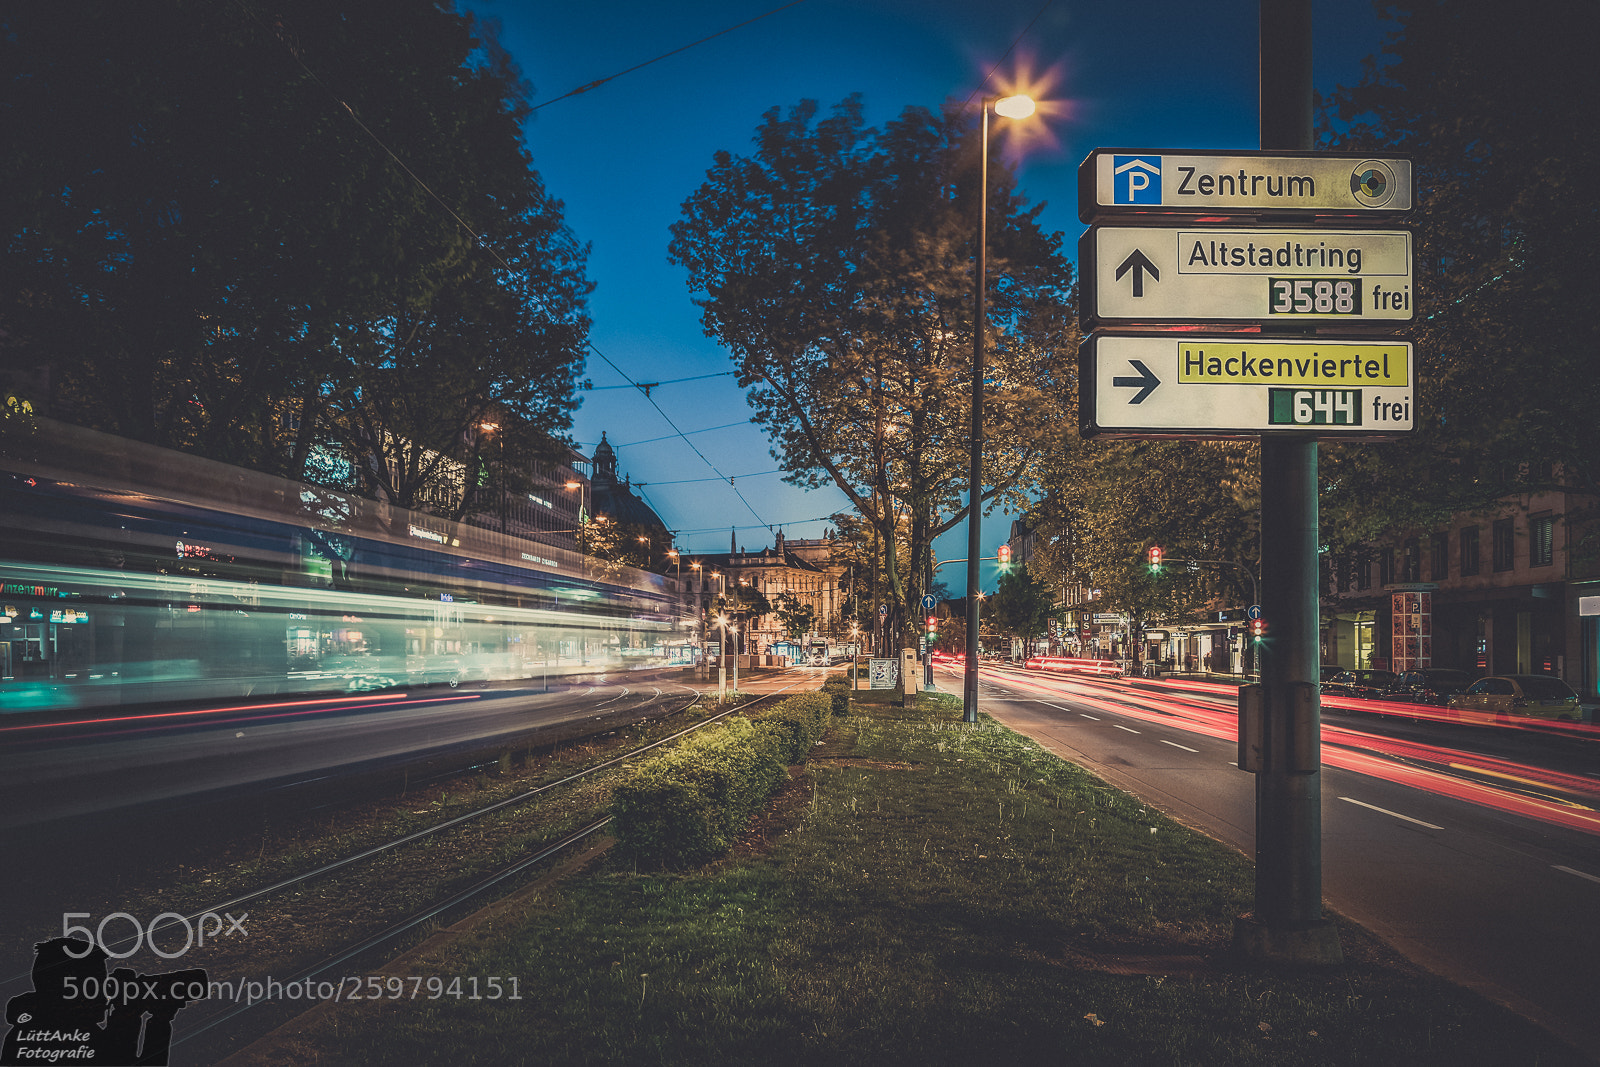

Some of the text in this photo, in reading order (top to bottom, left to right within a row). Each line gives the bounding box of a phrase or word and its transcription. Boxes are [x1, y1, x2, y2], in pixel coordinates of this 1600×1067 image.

[1128, 166, 1315, 202] P Zentrum
[1188, 240, 1363, 274] Altstadtring
[1273, 280, 1410, 313] 3588 frei
[1184, 350, 1392, 379] Hackenviertel
[1293, 391, 1410, 424] 644 frei
